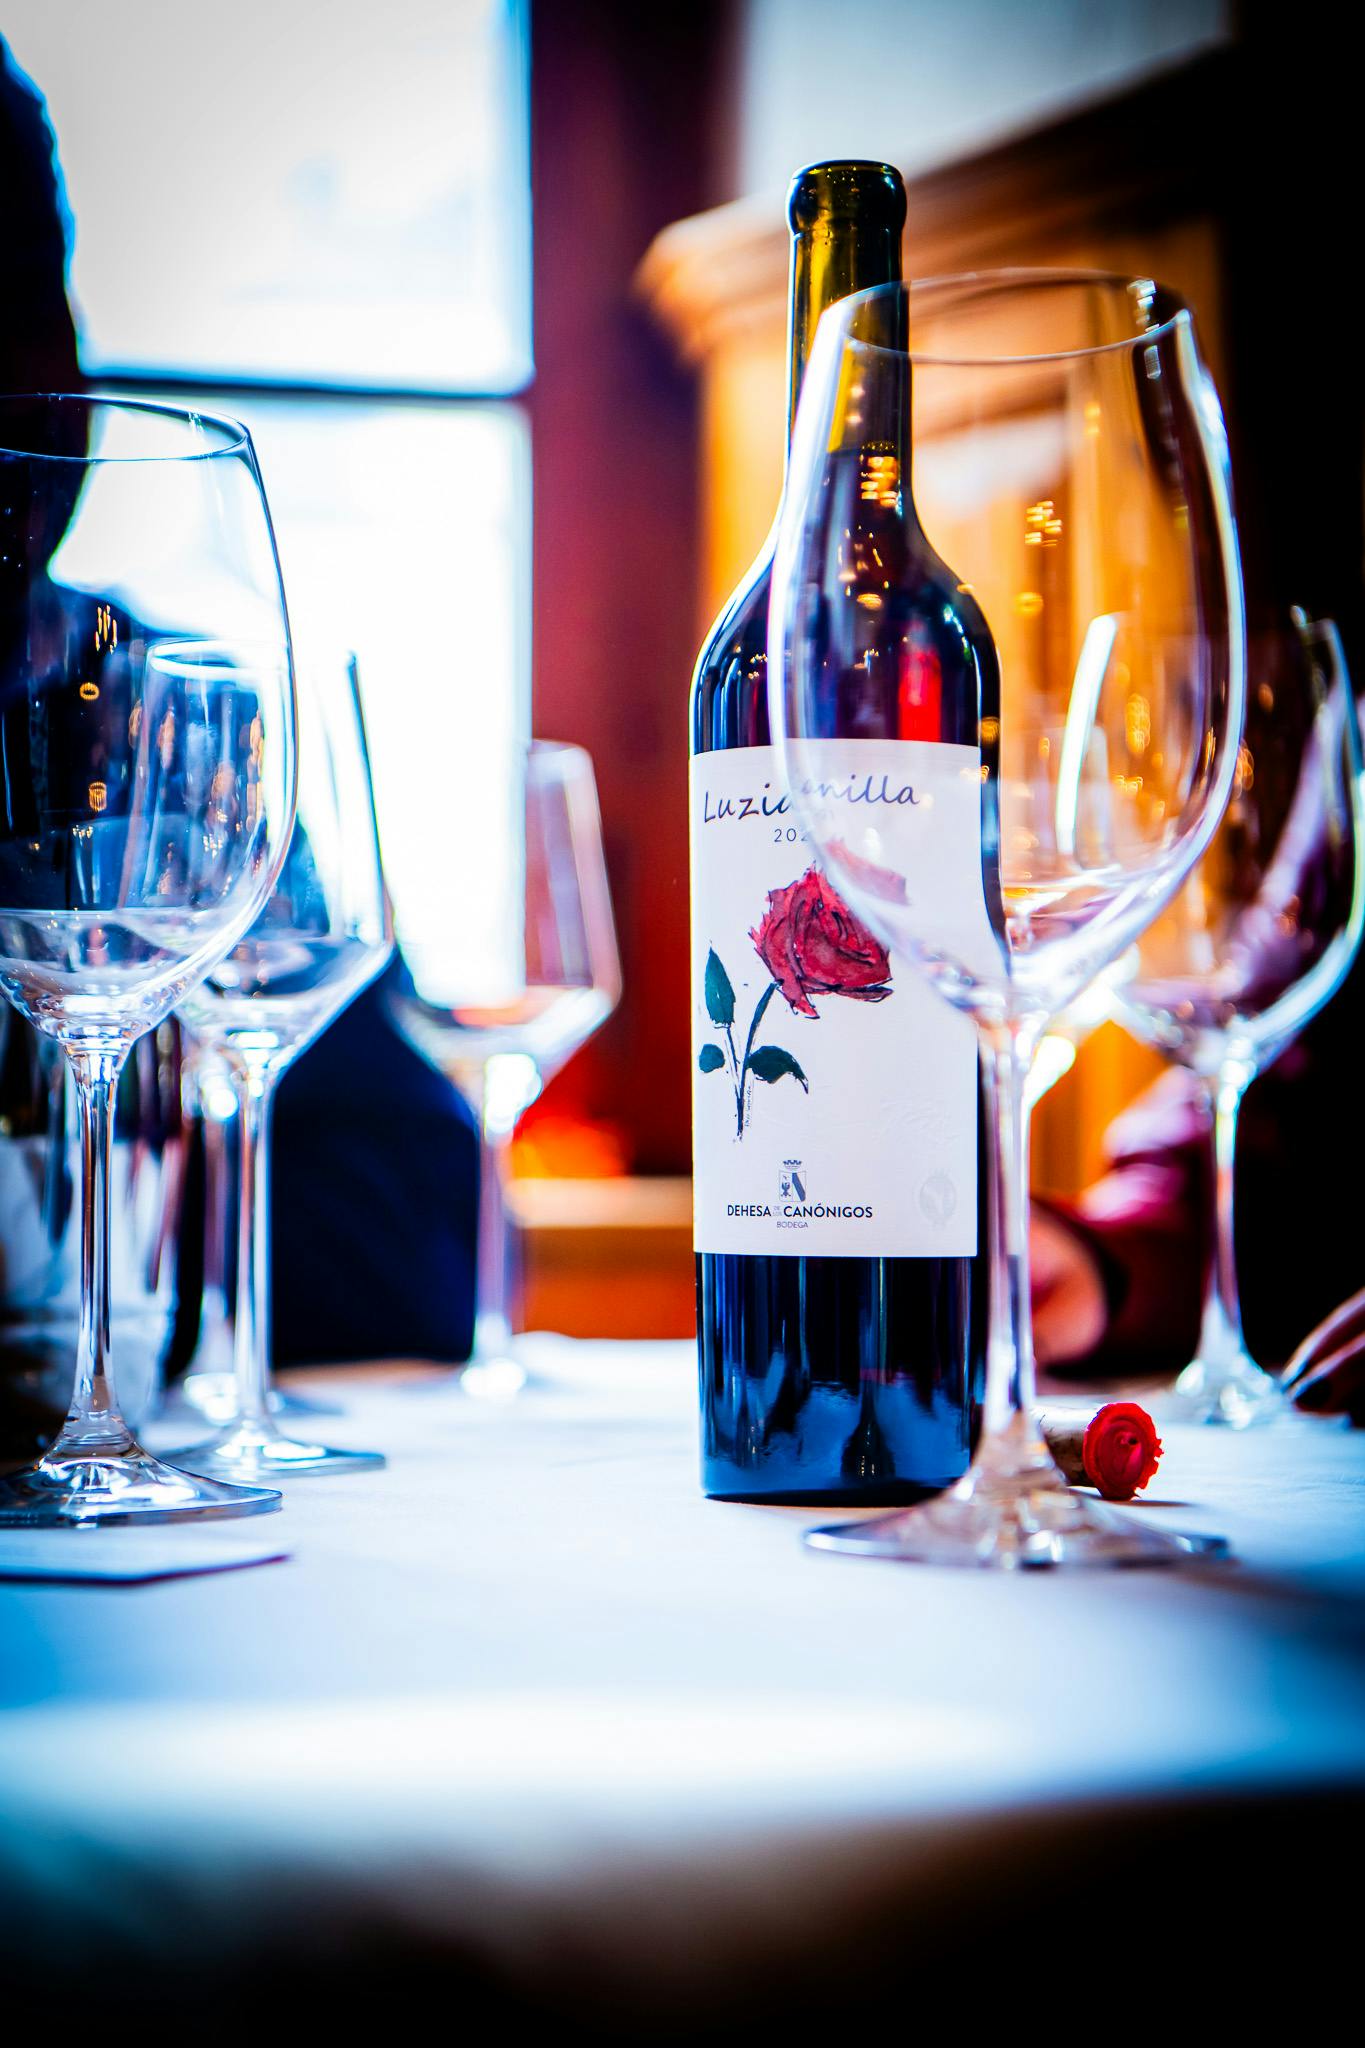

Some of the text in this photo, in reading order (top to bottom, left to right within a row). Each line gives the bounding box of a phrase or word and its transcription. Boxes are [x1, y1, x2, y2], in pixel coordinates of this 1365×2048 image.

[727, 1205, 772, 1217] DEHESA
[783, 1203, 873, 1218] CANÓNIGOS
[776, 1221, 809, 1229] BODEGA
